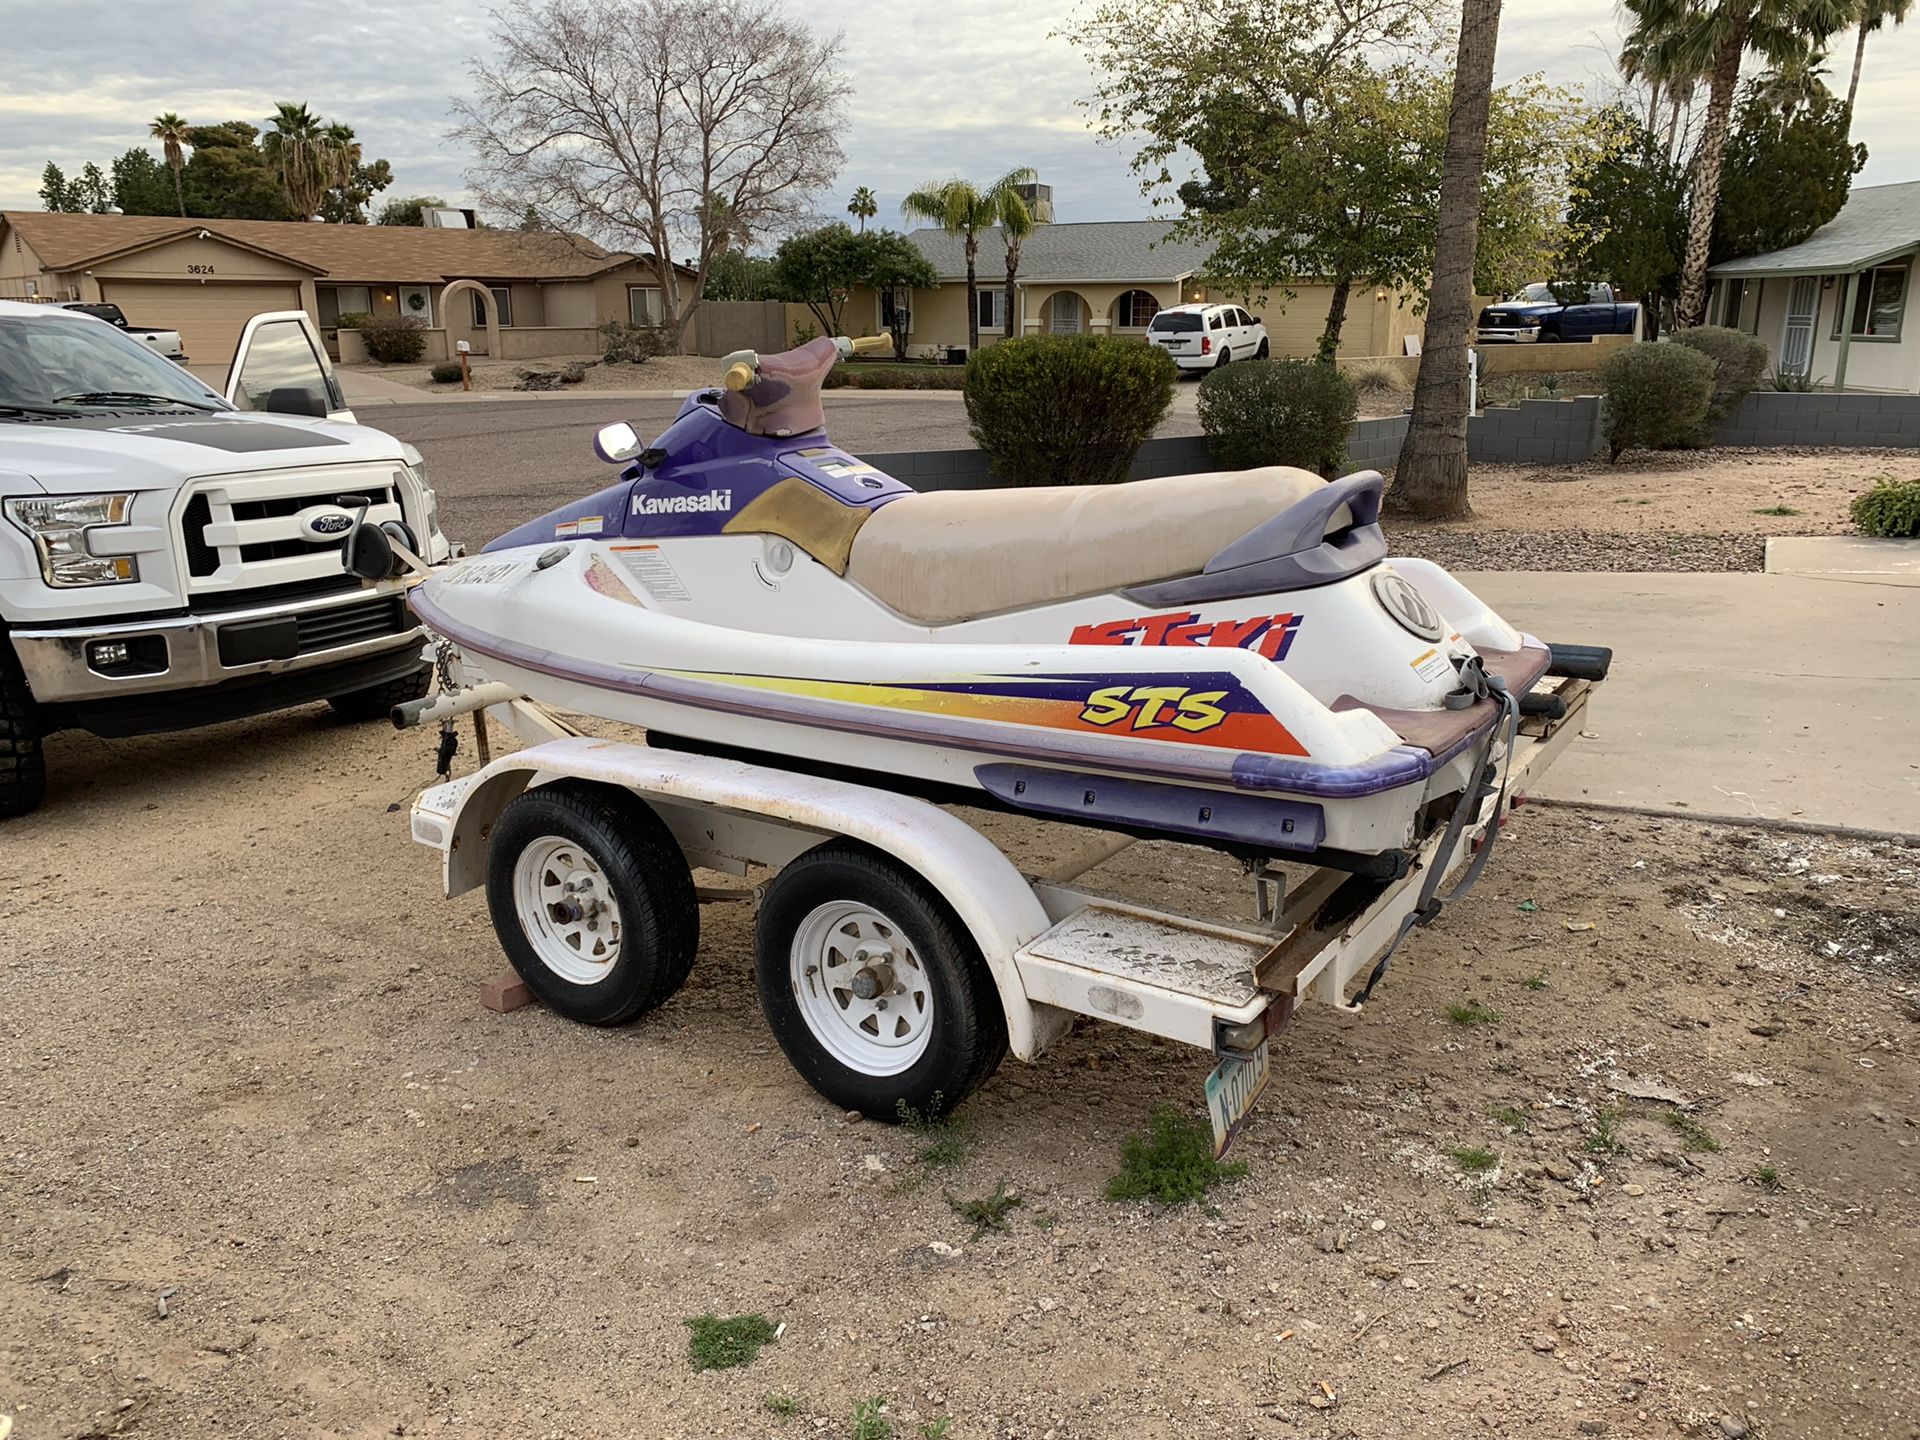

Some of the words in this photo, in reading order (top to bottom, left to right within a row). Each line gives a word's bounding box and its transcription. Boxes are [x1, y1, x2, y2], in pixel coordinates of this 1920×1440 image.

[187, 264, 214, 274] 3624
[631, 489, 732, 516] Kawasaki
[320, 515, 347, 532] Ford
[1079, 686, 1230, 733] STS
